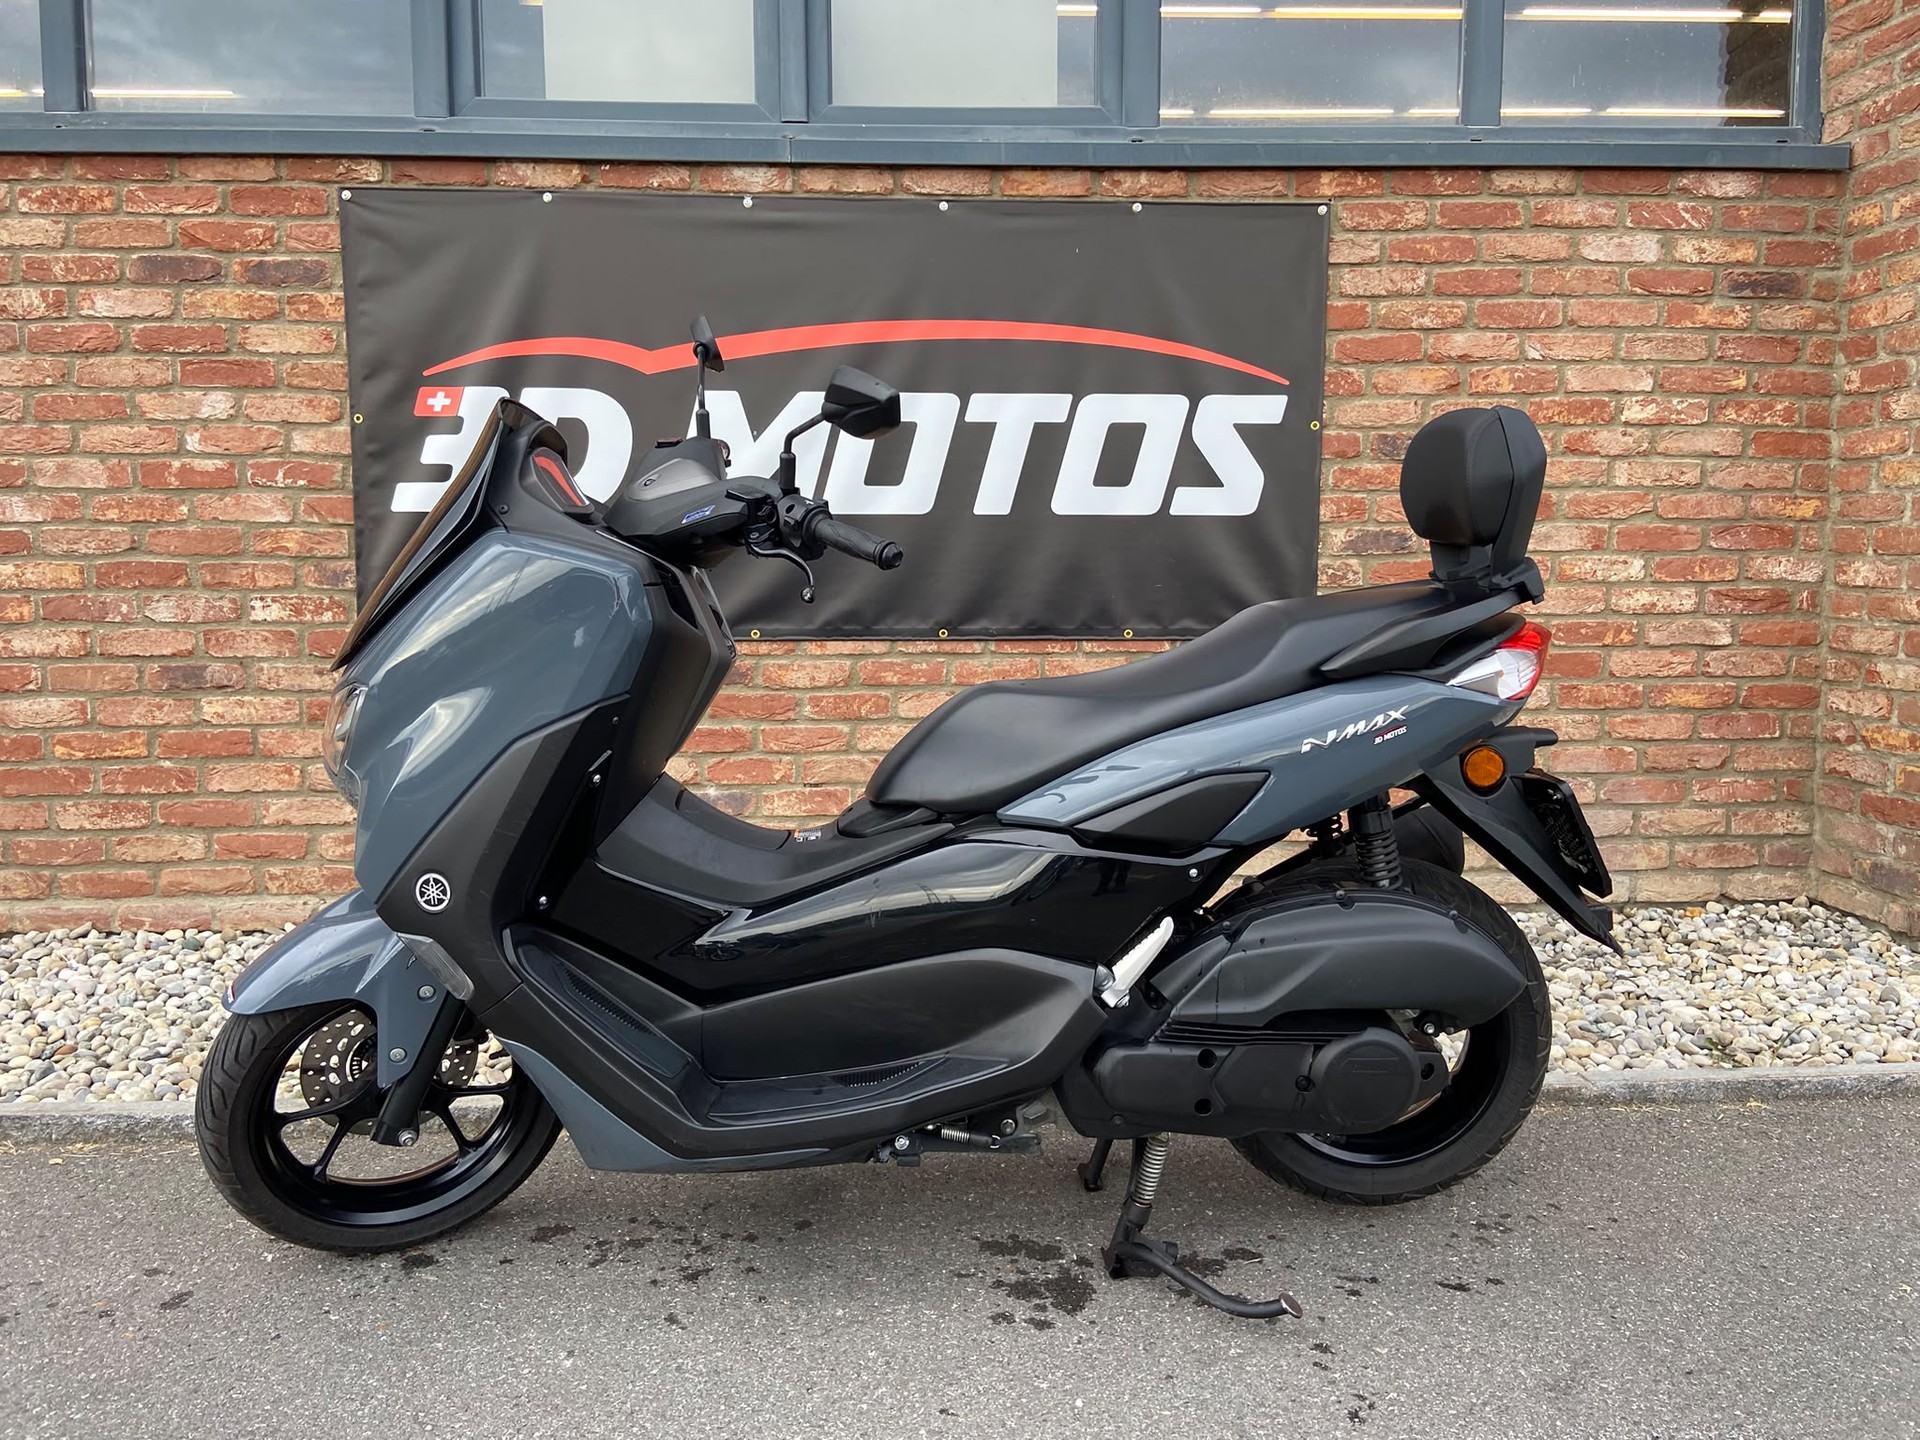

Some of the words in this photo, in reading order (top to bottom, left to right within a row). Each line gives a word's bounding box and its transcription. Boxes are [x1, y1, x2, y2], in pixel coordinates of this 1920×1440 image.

[390, 386, 633, 513] 3D
[683, 390, 1289, 516] MOTOS
[1301, 704, 1409, 753] NMAX
[1384, 726, 1407, 740] MOTOS
